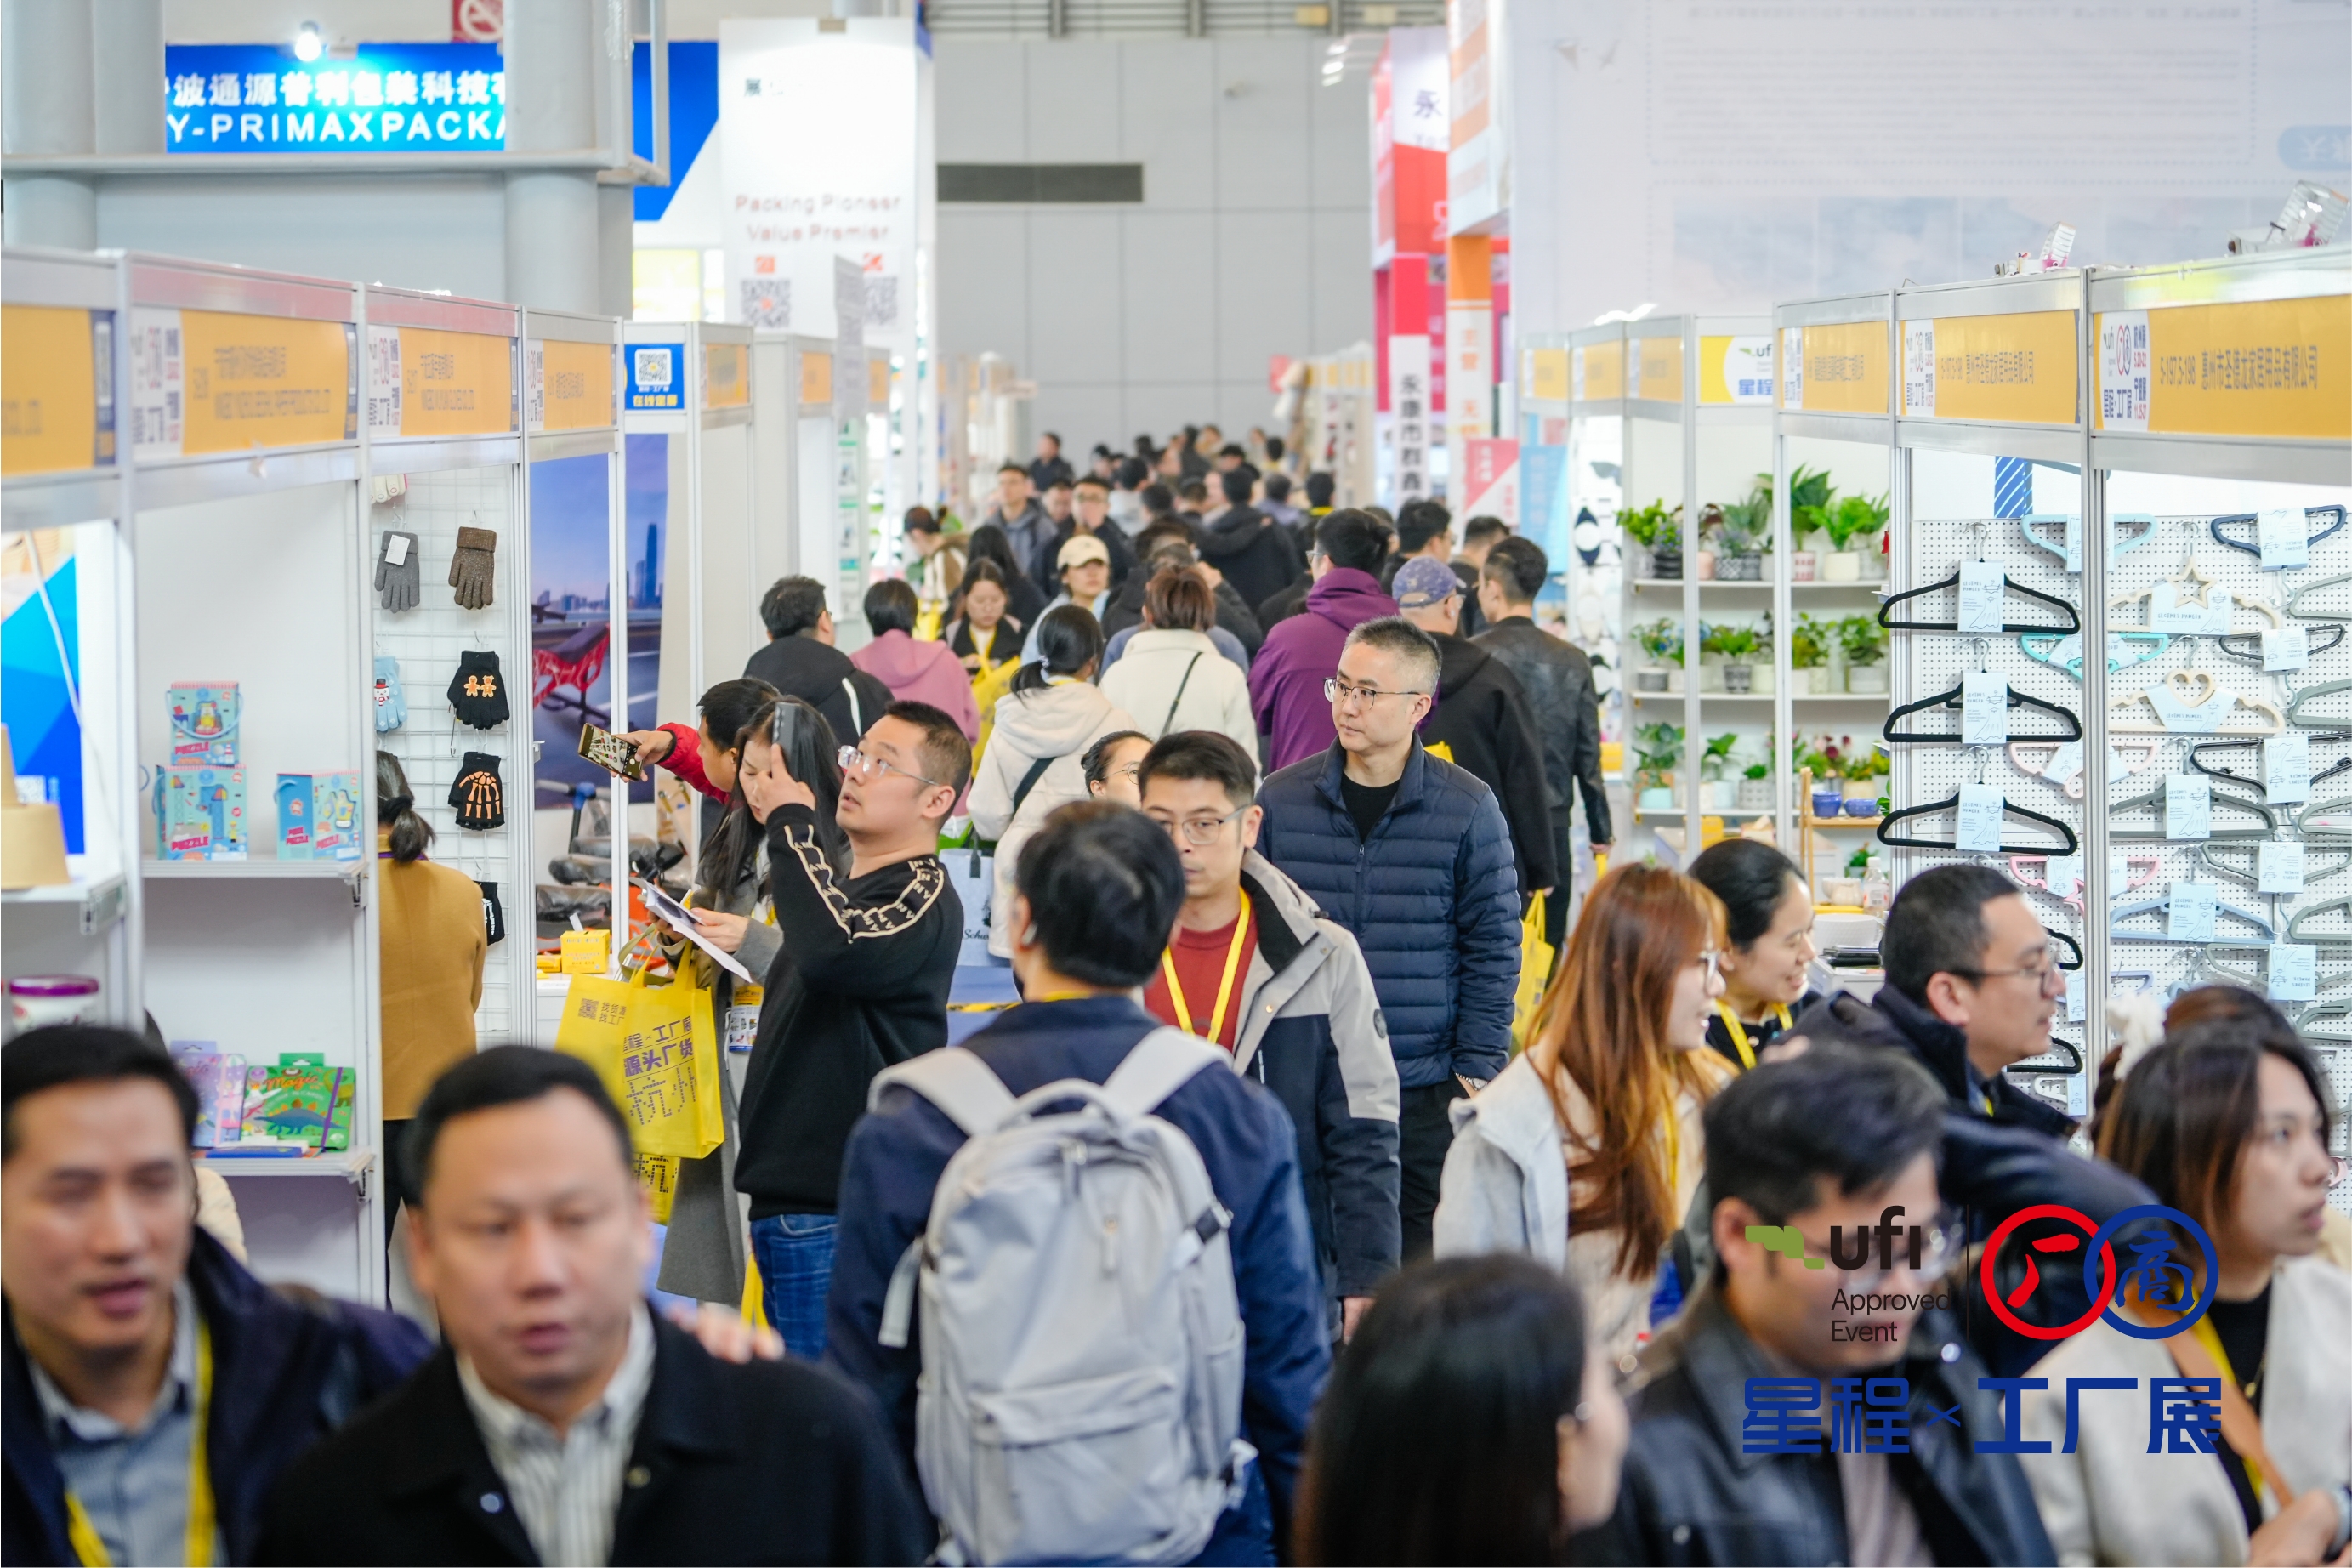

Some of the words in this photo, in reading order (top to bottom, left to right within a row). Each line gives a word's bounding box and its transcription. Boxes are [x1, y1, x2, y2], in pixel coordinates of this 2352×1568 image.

[165, 71, 506, 107] 波通源普利包装科技
[736, 194, 815, 215] Packing
[747, 224, 803, 242] Value
[810, 223, 889, 241] Premier
[263, 1072, 319, 1092] Magic
